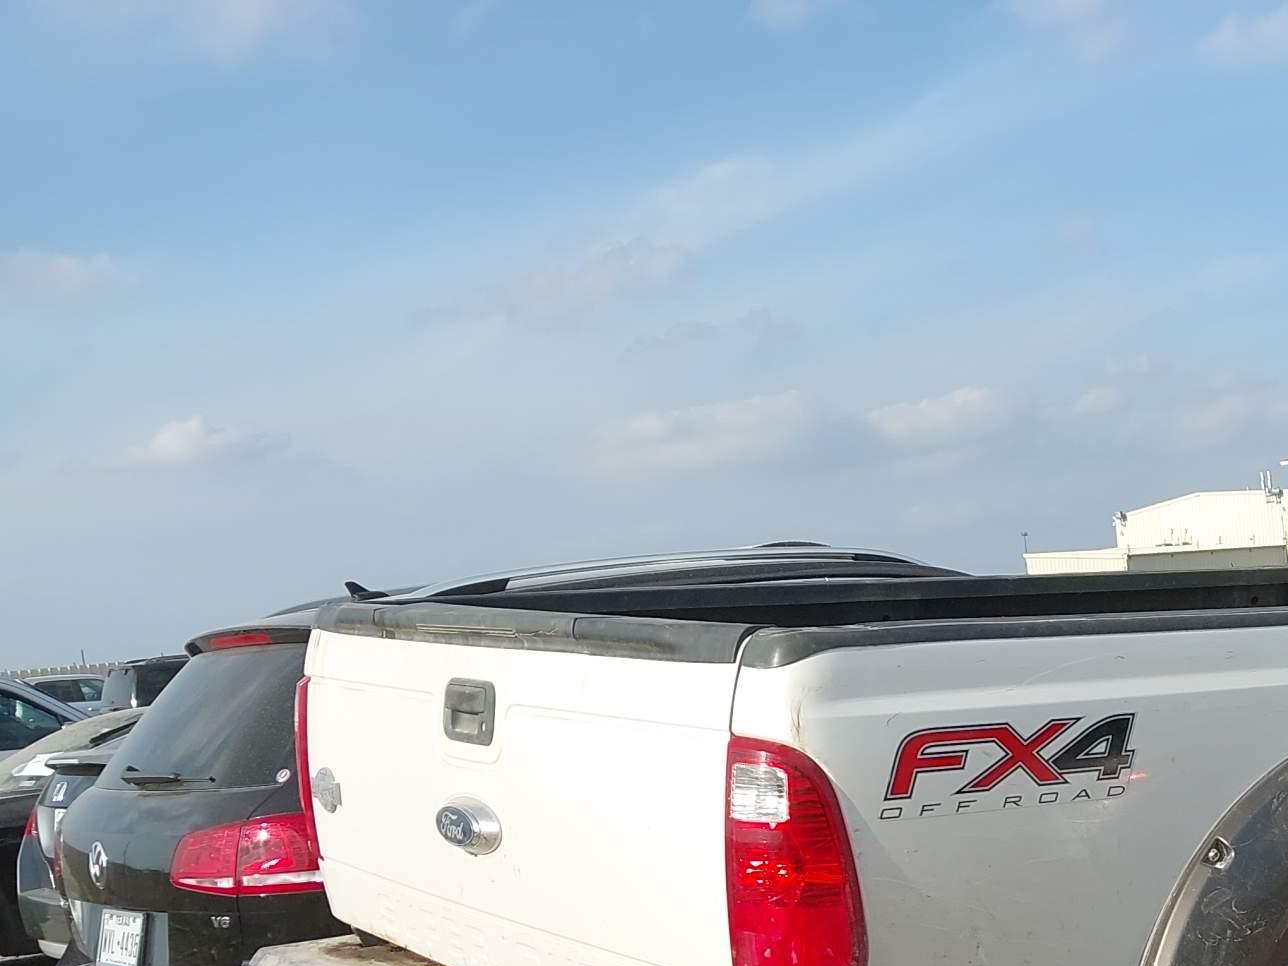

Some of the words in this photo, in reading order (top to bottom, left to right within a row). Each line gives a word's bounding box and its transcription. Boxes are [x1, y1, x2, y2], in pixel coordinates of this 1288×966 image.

[883, 712, 1136, 801] FX4
[880, 799, 978, 820] OFF
[1003, 785, 1126, 808] ROAD
[440, 811, 465, 840] Ford
[210, 916, 230, 928] V6
